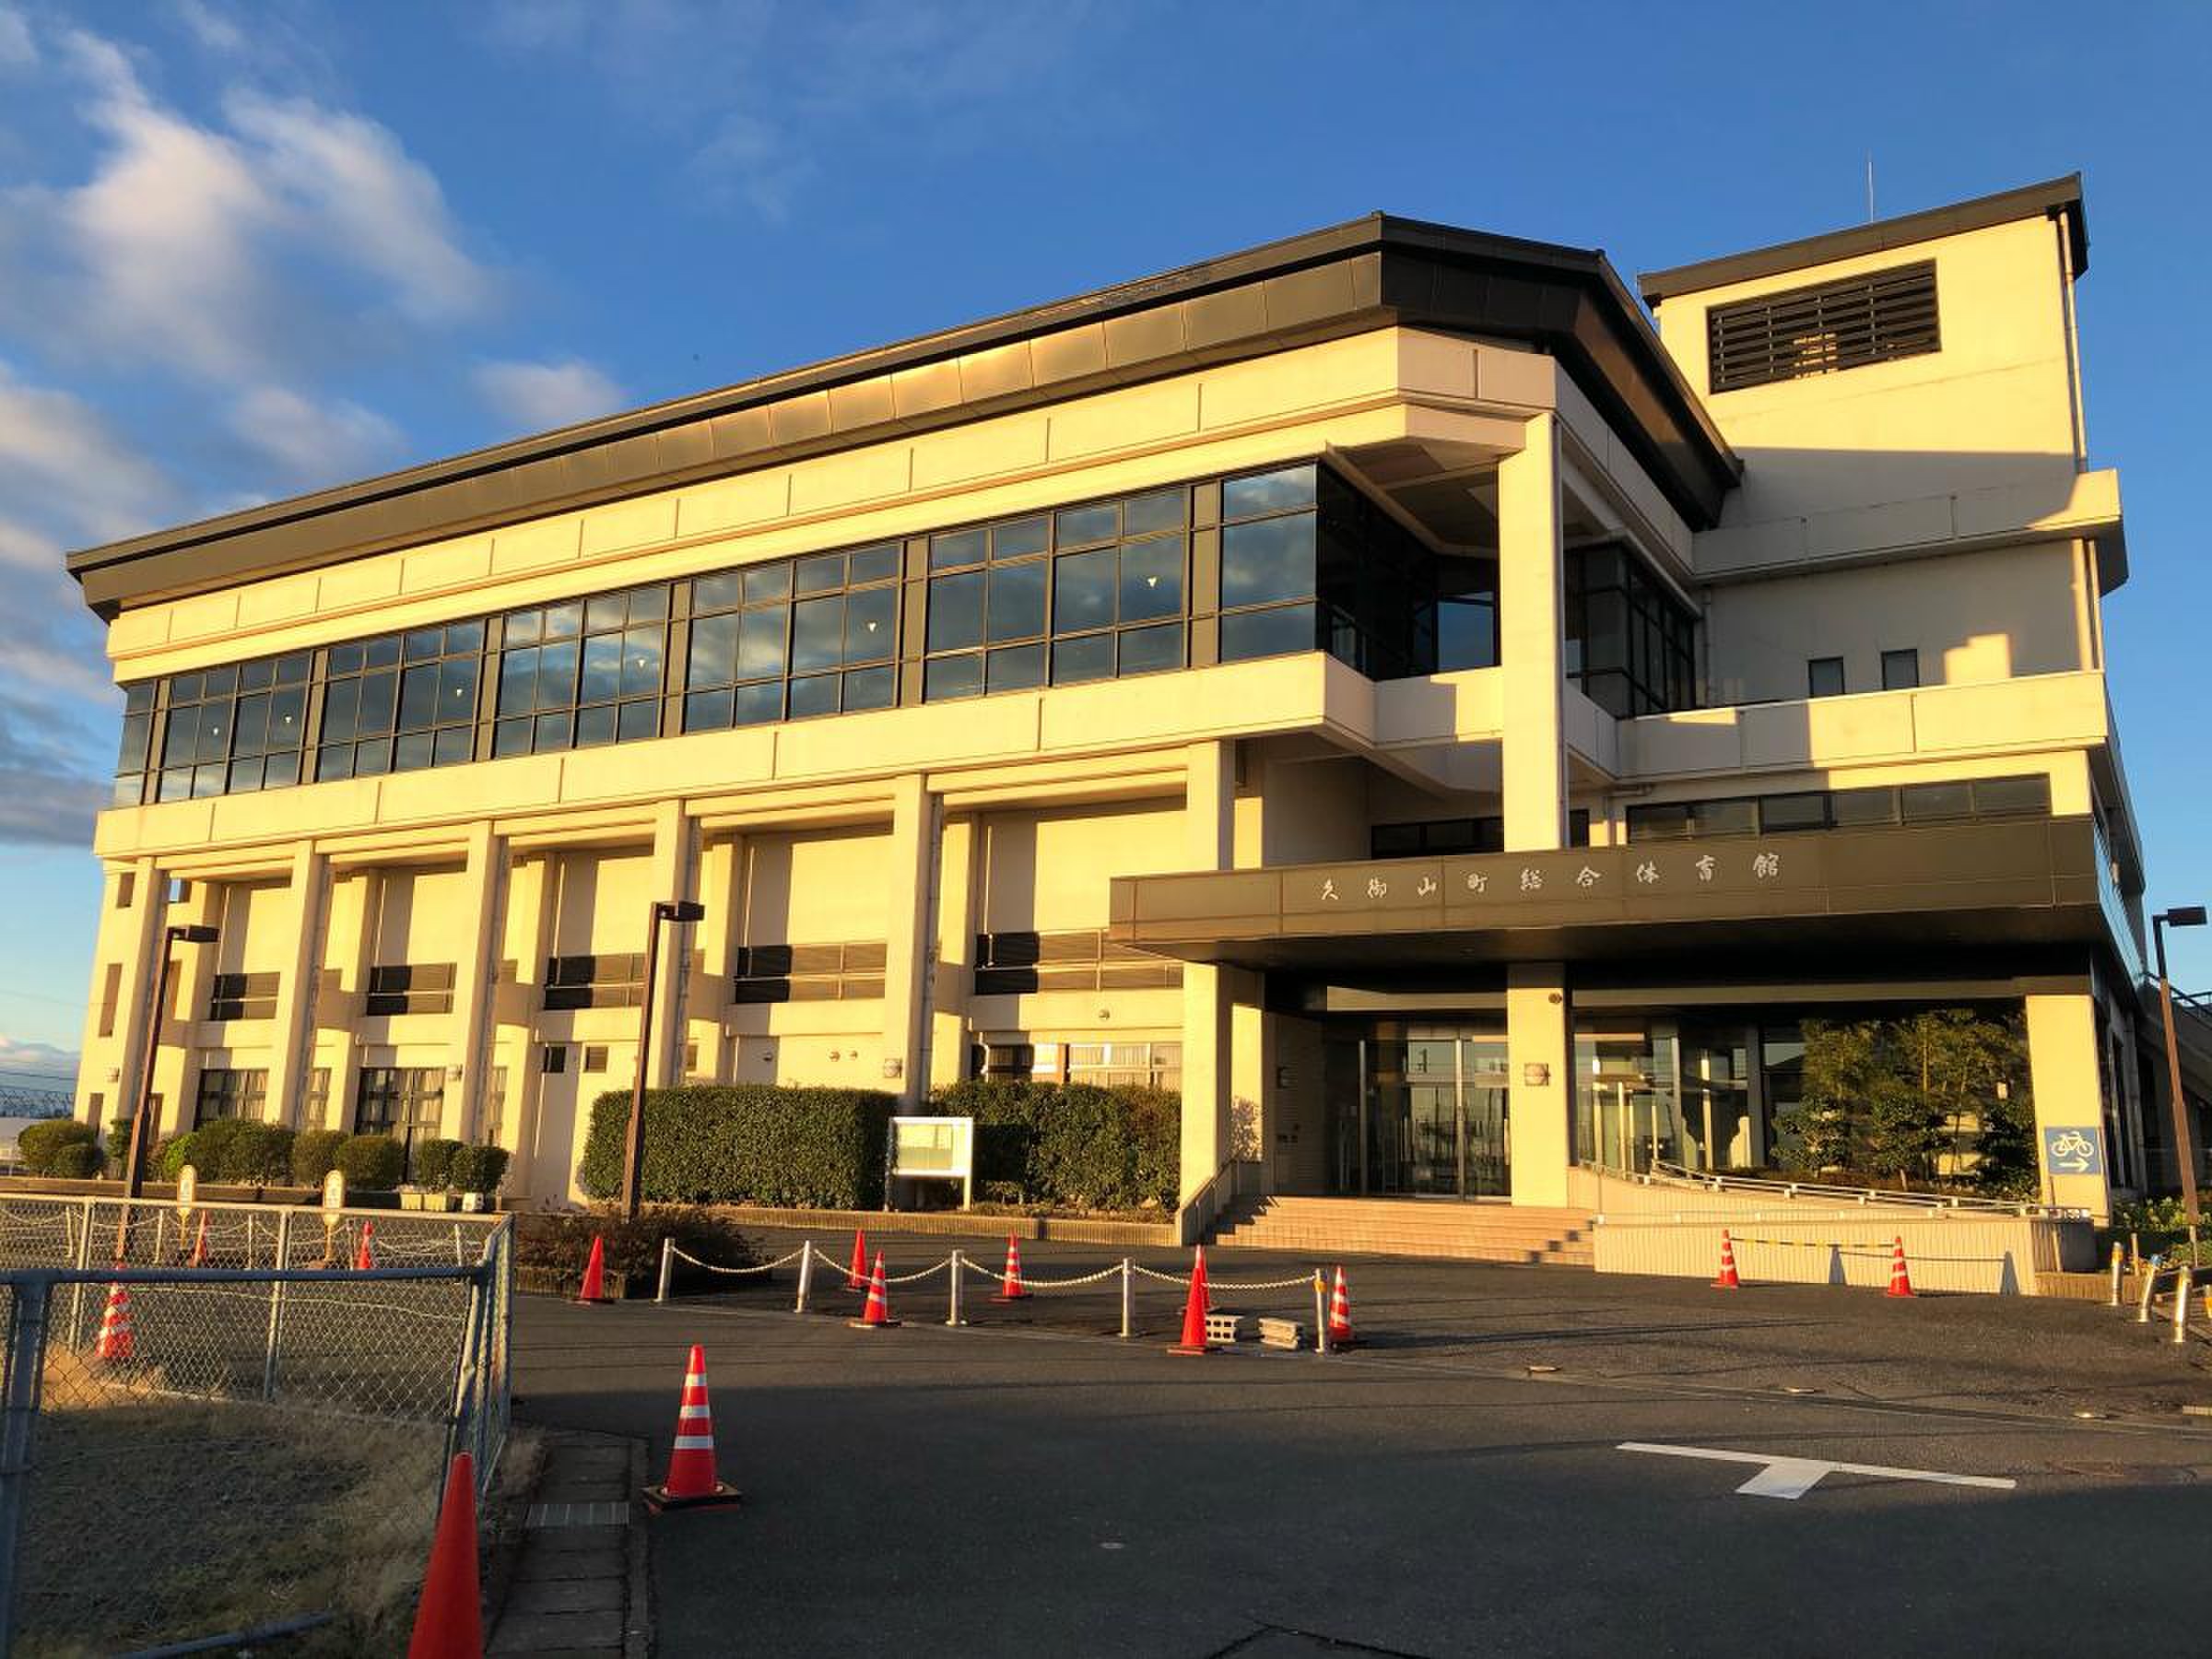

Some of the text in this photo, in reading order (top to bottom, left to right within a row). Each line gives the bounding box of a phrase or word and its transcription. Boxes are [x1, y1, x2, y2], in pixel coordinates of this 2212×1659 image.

[1321, 853, 1779, 900] 久御山町総合体育館
